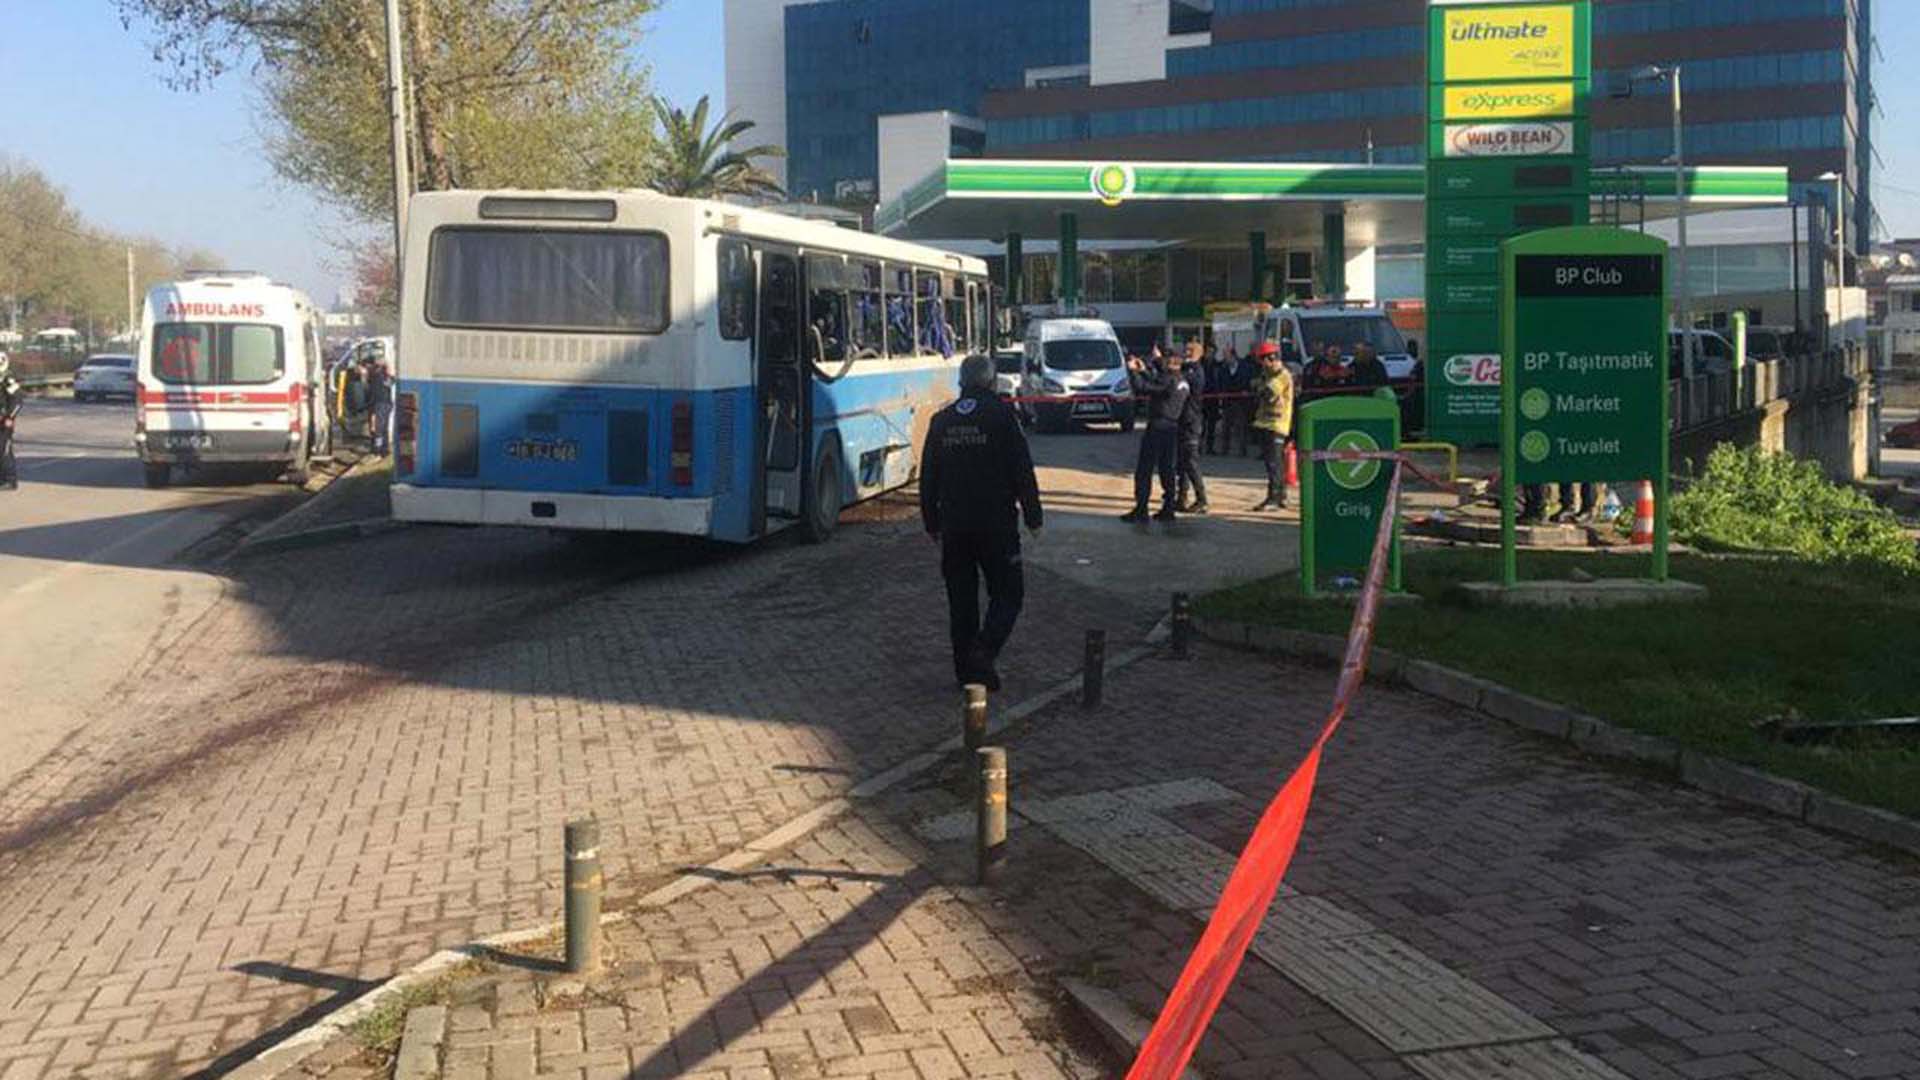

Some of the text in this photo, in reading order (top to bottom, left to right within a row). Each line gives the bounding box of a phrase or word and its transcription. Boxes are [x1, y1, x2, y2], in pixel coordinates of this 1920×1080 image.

[1451, 20, 1547, 41] ultimate
[1462, 91, 1556, 111] express
[1467, 130, 1552, 145] WILD BEAN
[1556, 267, 1622, 284] BP Club
[165, 303, 265, 318] AMBULANS
[1524, 351, 1654, 375] BP Taşıtmatik
[1556, 394, 1620, 412] Market
[1557, 438, 1620, 455] Tuvalet
[1334, 501, 1372, 520] Giriş
